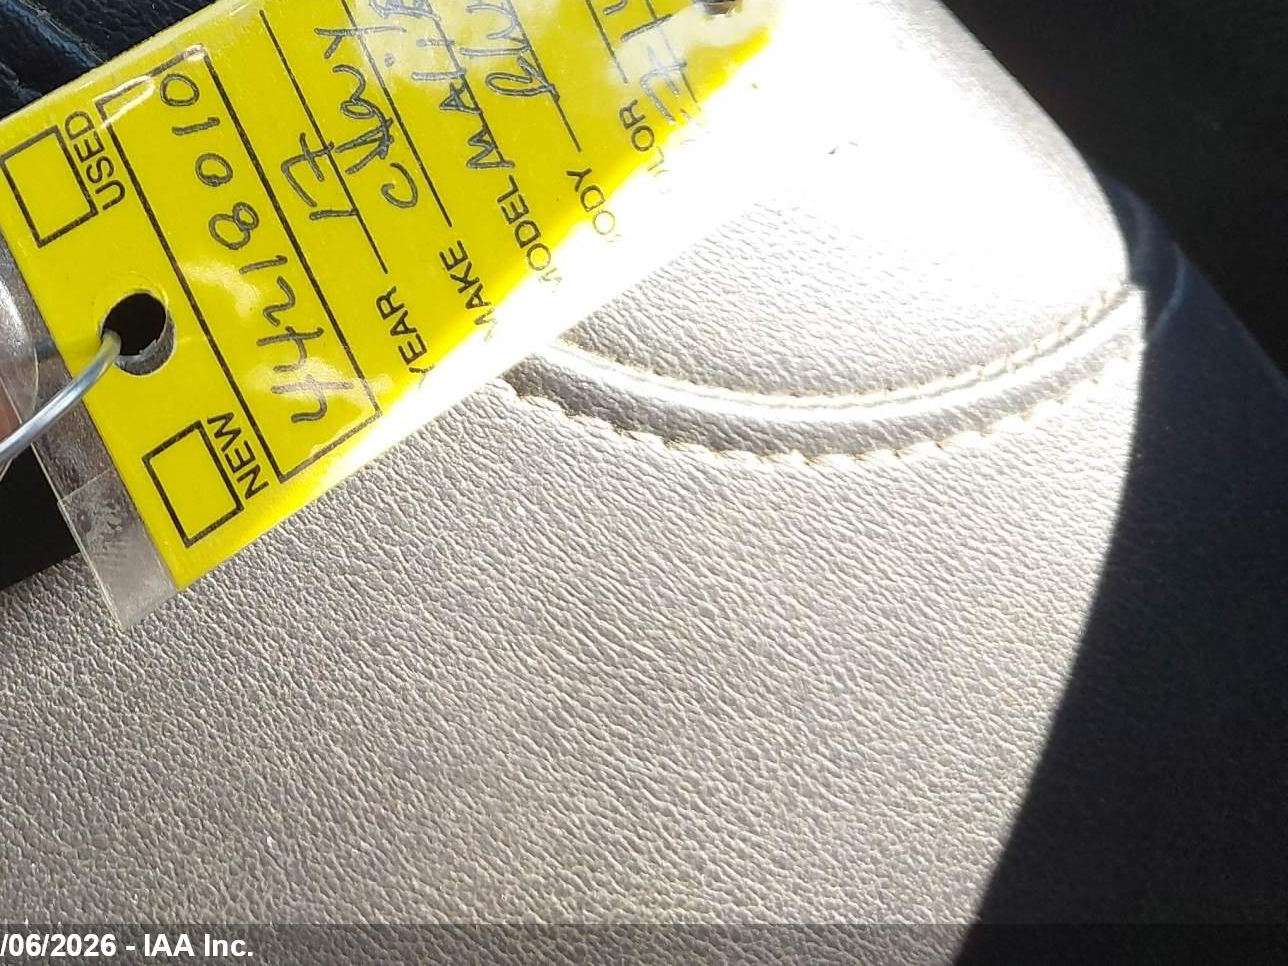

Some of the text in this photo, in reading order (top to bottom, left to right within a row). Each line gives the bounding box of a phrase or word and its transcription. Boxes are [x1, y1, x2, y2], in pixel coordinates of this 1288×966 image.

[64, 110, 125, 211] USED
[565, 166, 622, 242] ODY
[159, 74, 354, 423] 44218010
[375, 285, 435, 387] YEAR
[207, 411, 269, 500] NEW
